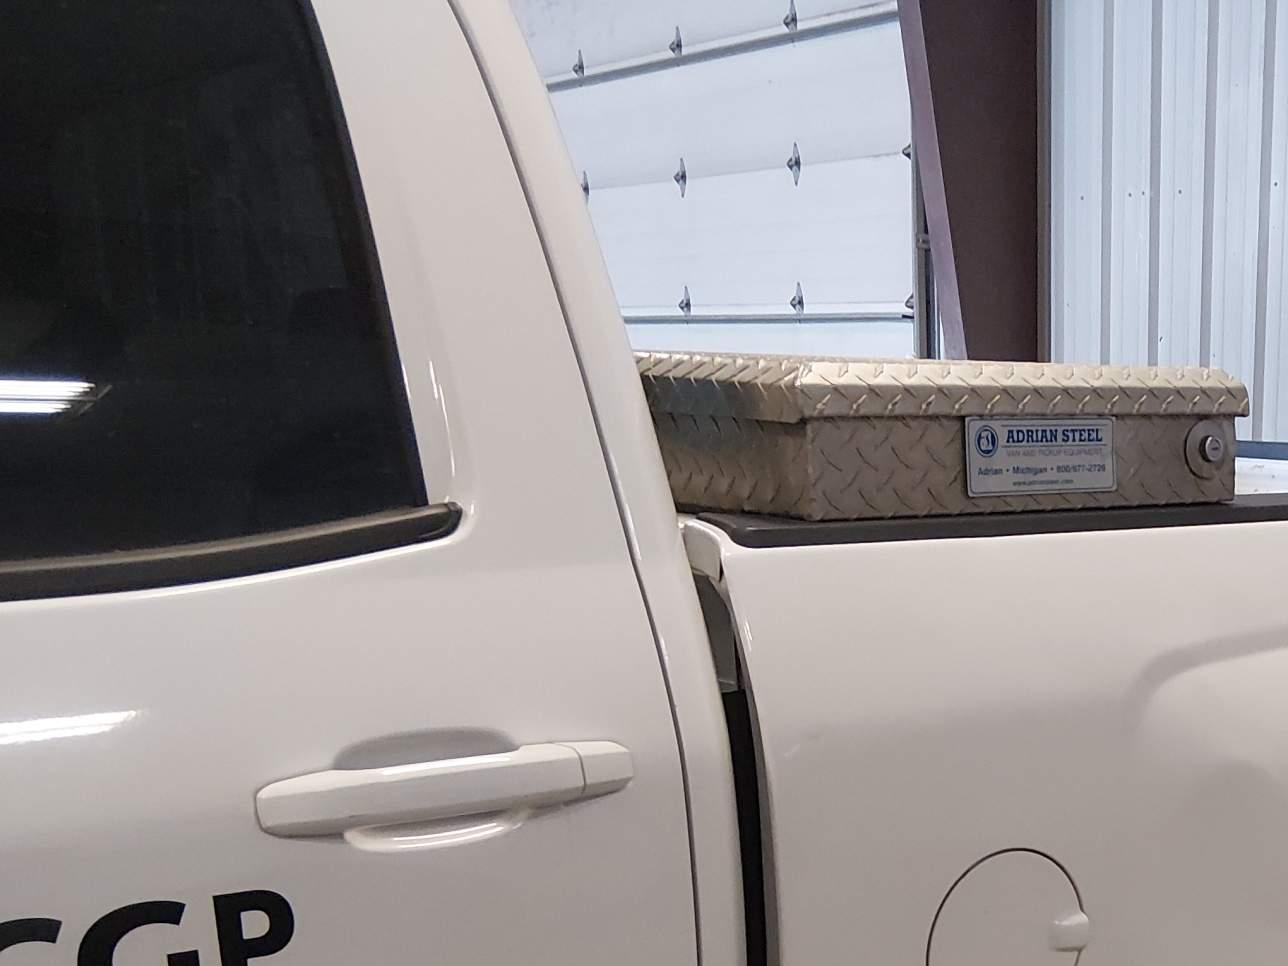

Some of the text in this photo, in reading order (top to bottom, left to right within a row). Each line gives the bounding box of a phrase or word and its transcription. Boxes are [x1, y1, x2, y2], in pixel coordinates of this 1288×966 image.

[1006, 428, 1103, 443] ADRIAN STEEL
[1006, 449, 1020, 457] VAN
[978, 466, 1003, 476] Adrian
[1012, 465, 1048, 476] Michigan
